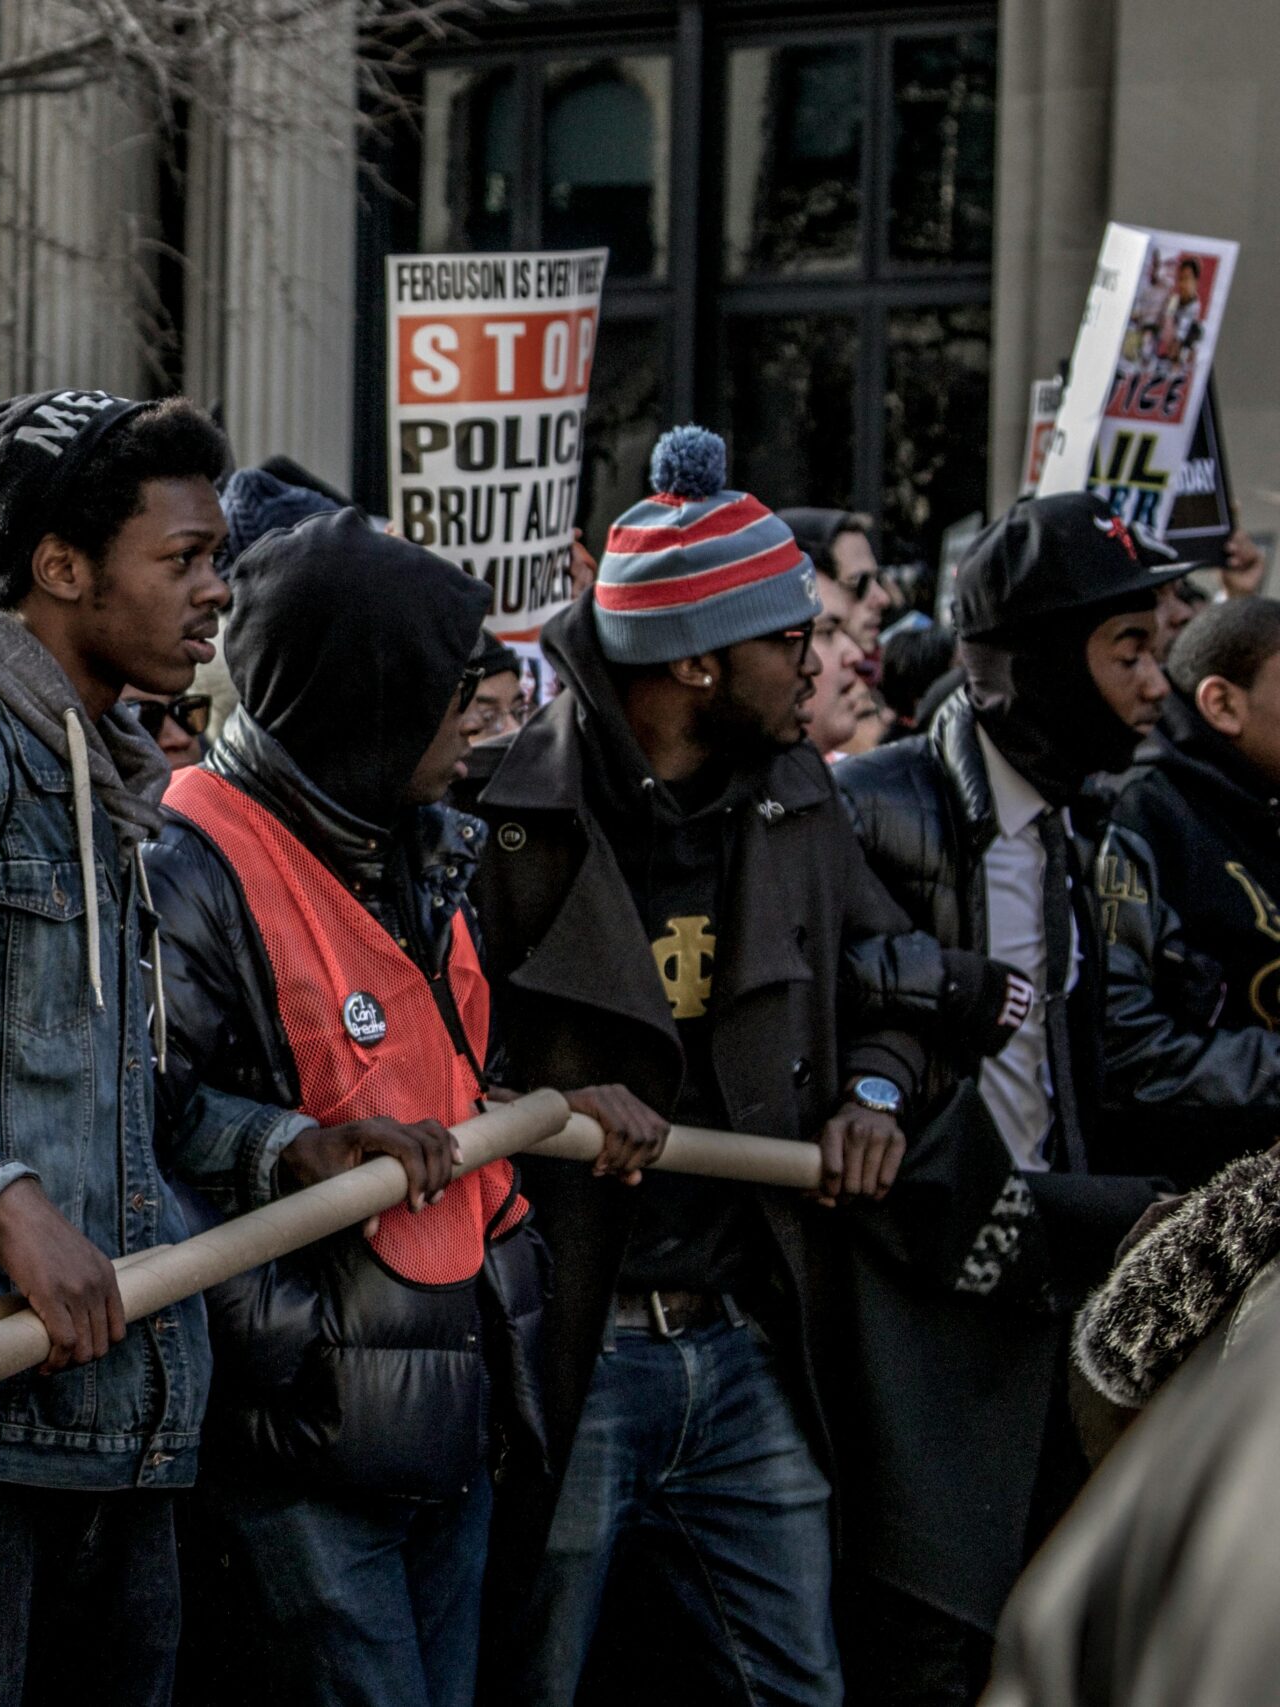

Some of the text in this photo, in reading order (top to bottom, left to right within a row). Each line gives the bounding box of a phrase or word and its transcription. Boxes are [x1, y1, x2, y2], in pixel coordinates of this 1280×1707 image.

[397, 260, 507, 302] FERGUSON
[512, 259, 531, 299] IS
[411, 317, 593, 396] STOP
[402, 476, 578, 547] BRUTALIT
[352, 1003, 377, 1022] Can't
[357, 995, 366, 1009] I
[351, 1020, 387, 1037] Breathe
